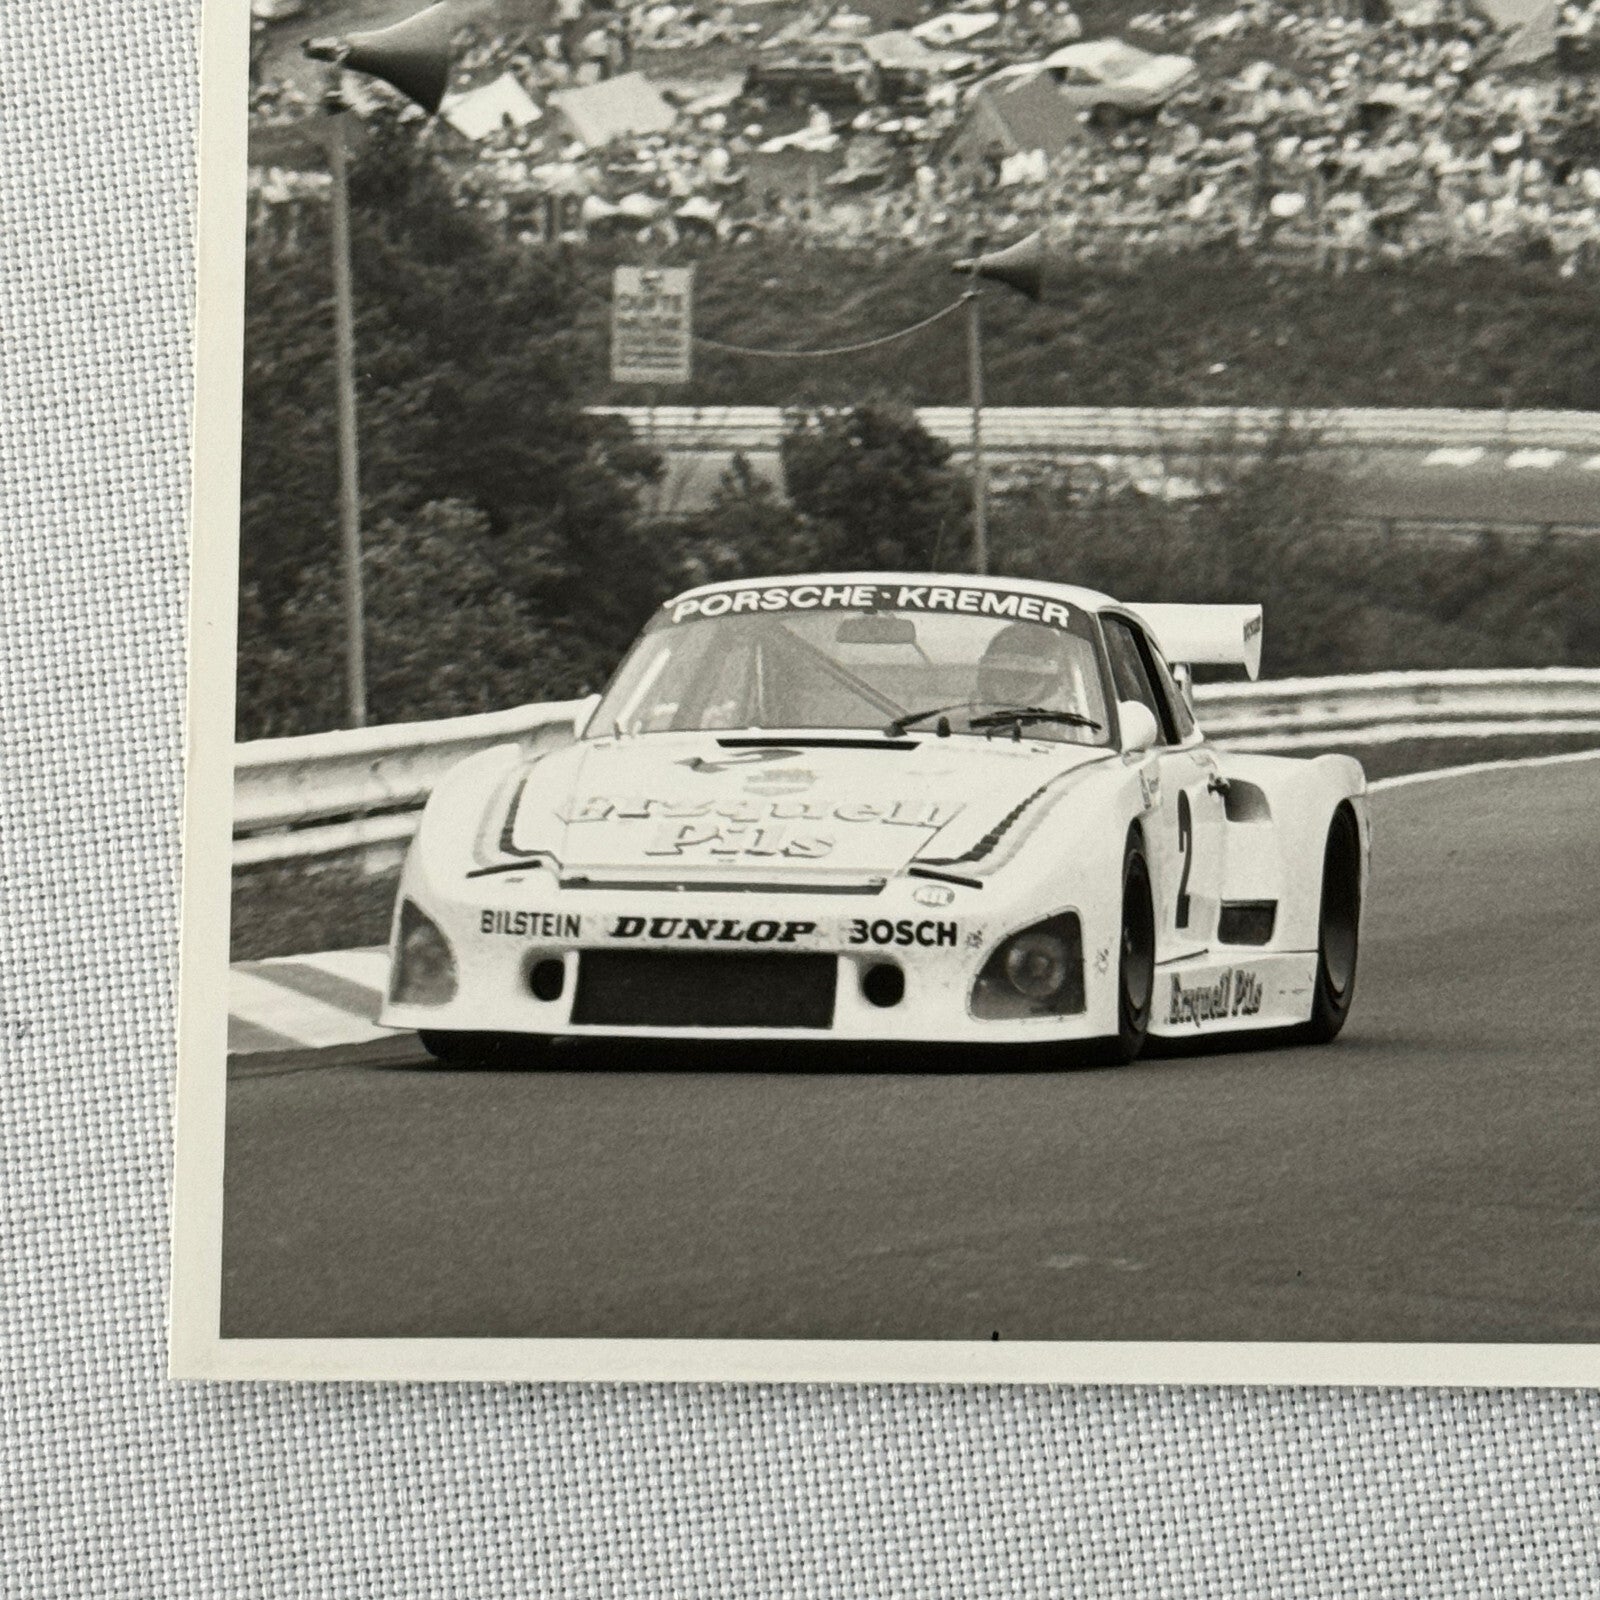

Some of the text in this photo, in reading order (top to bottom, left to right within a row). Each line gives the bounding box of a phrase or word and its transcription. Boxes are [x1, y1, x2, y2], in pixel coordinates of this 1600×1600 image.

[672, 586, 1070, 628] PORSCHE KREMER
[480, 909, 581, 938] BILSTEIN
[609, 916, 817, 942] DUNLOP
[848, 918, 958, 947] BOSCH
